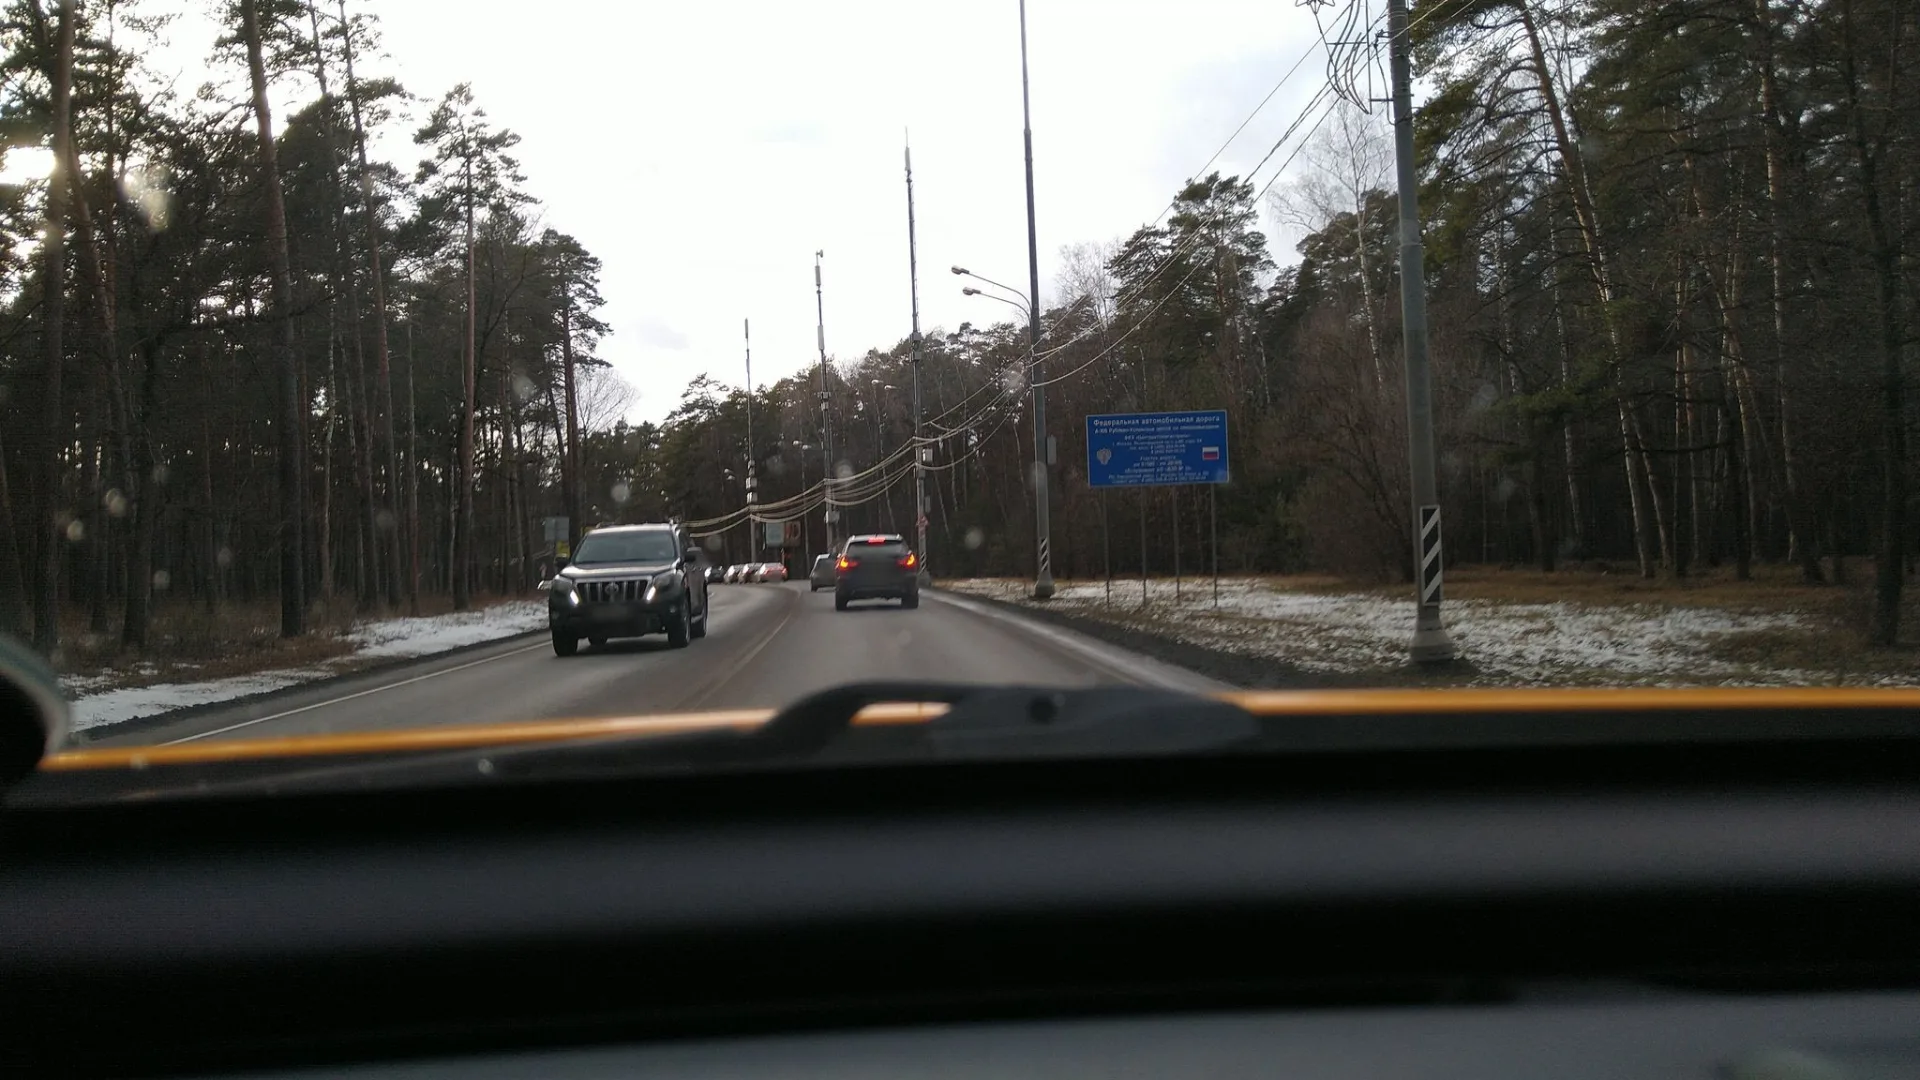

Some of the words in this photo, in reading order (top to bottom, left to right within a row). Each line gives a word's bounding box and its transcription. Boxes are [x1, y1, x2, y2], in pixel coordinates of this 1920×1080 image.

[1093, 419, 1140, 427] Федеральная
[1142, 416, 1194, 425] автомобильная
[1196, 415, 1220, 423] дорога
